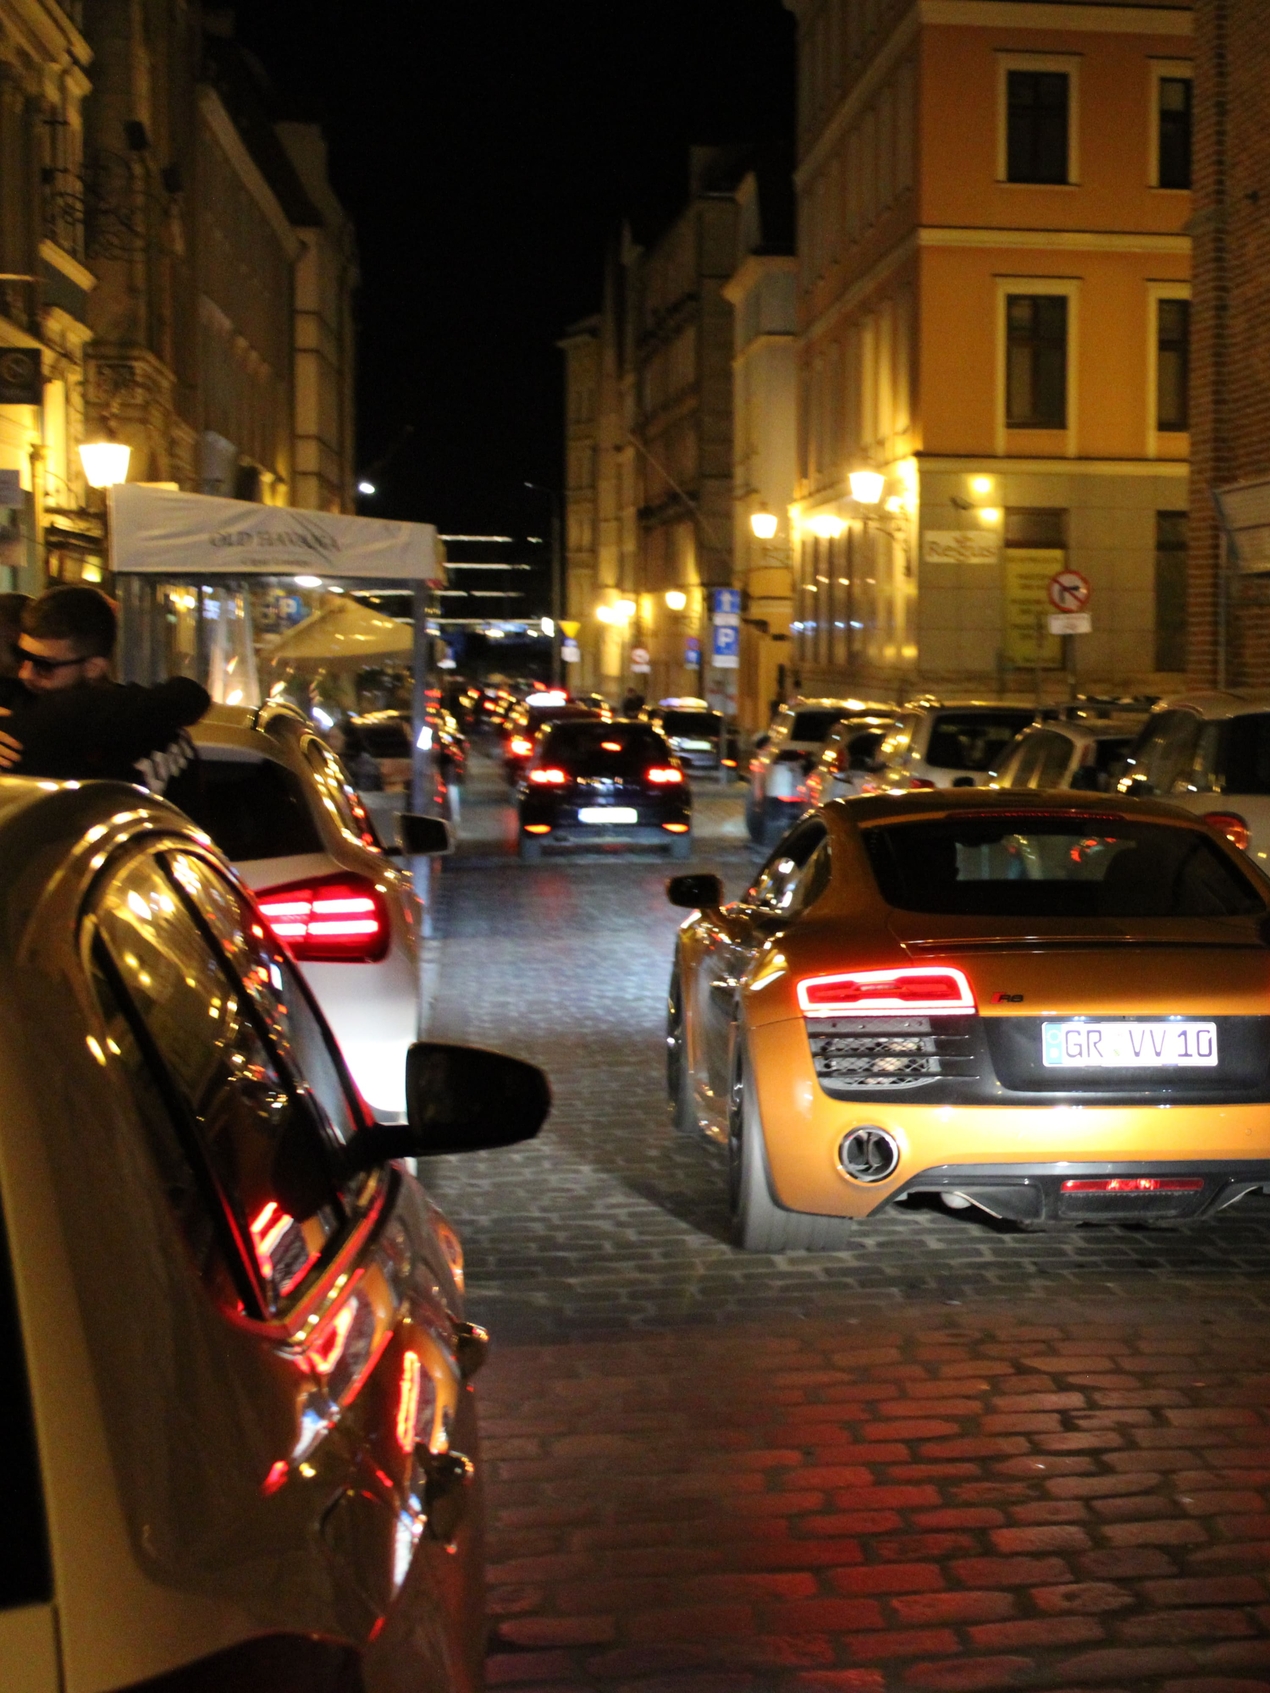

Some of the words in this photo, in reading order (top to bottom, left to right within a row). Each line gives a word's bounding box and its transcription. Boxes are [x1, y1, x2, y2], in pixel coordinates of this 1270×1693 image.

[718, 628, 735, 647] P
[1065, 1030, 1104, 1058] GR
[1129, 1030, 1166, 1057] VV
[1177, 1030, 1212, 1057] 10
